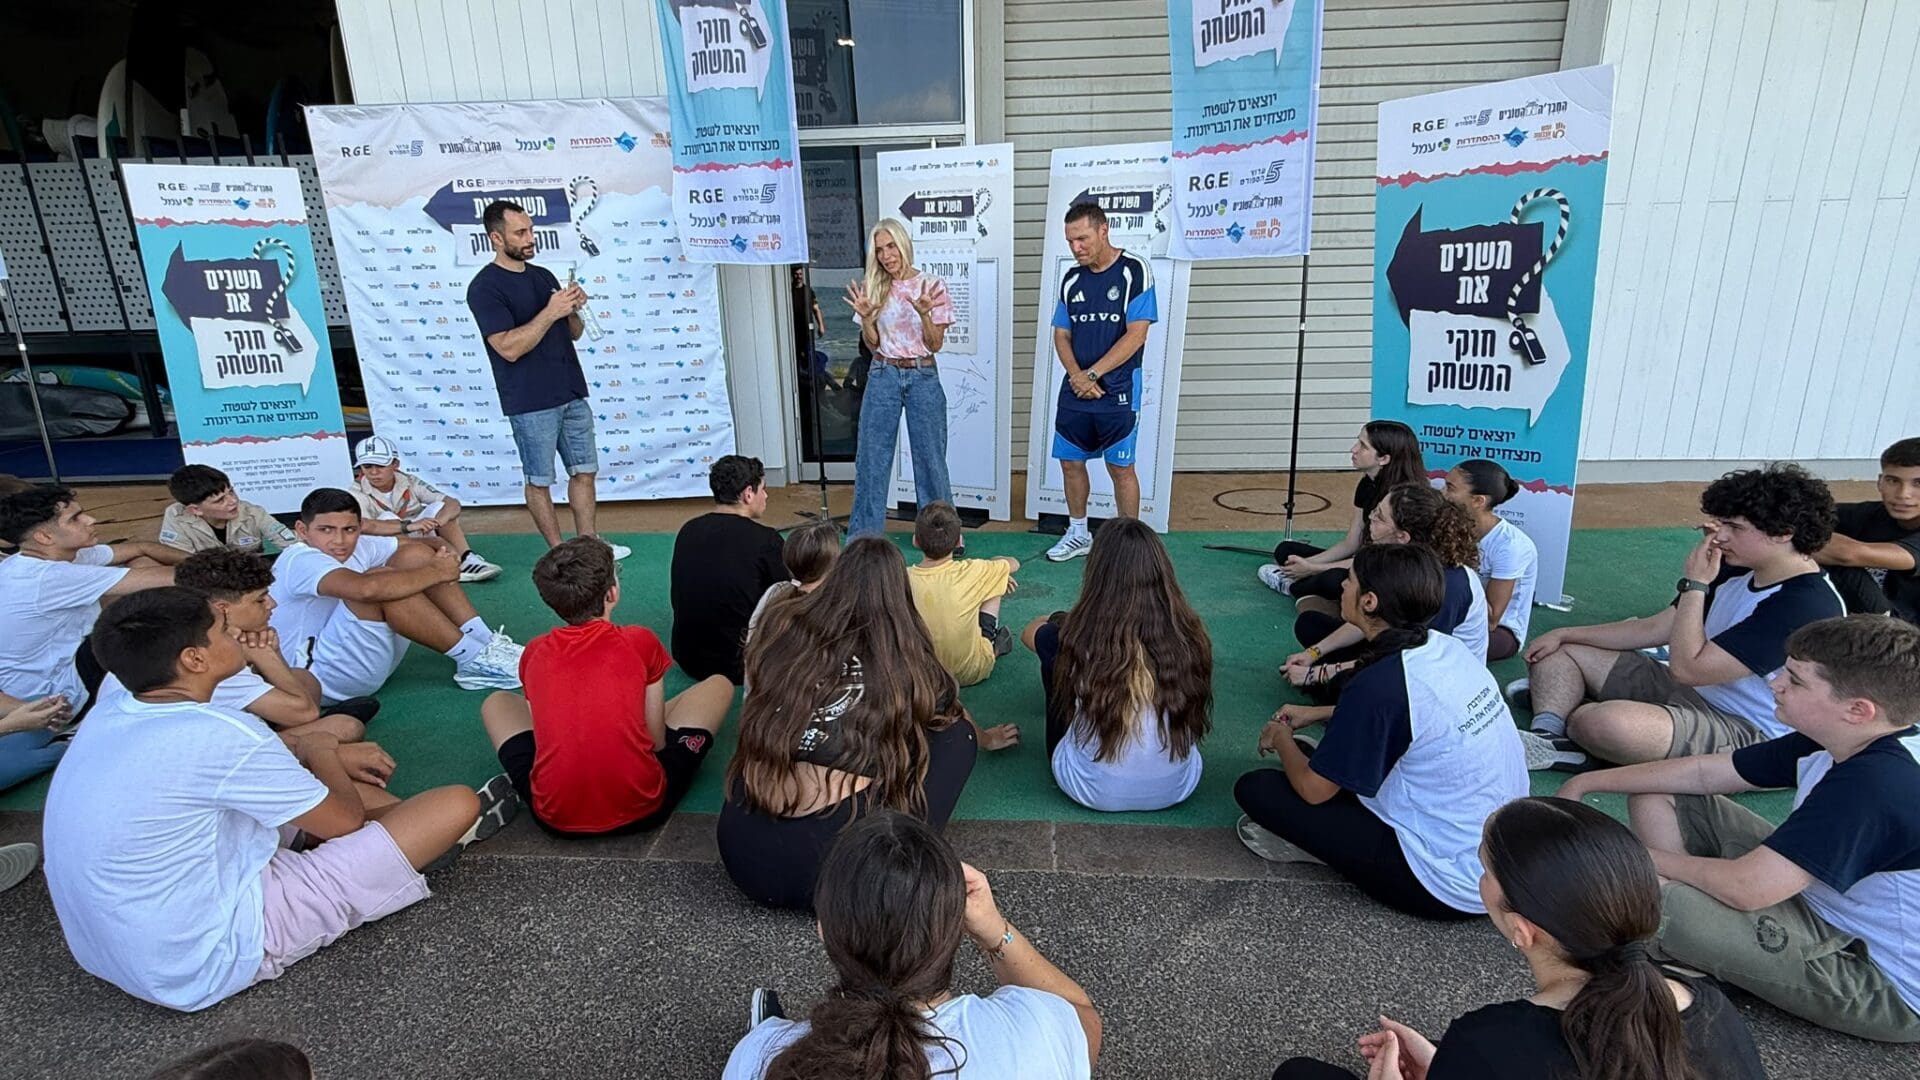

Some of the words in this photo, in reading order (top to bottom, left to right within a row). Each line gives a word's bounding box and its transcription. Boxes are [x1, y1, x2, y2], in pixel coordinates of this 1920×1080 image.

[697, 18, 731, 48] חוקי
[1200, 7, 1265, 53] המשחק
[692, 48, 746, 81] המשחק
[1238, 93, 1278, 111] יוצאים
[1233, 116, 1252, 130] את
[1254, 108, 1296, 127] מנצחים
[723, 124, 760, 135] יוצאים
[1184, 119, 1232, 140] הבריונות.
[516, 138, 542, 151] עמל
[570, 136, 612, 146] ההסתדרות
[720, 140, 736, 152] את
[738, 140, 780, 151] מנצחים
[1456, 133, 1500, 146] ההסתדרות
[1412, 142, 1436, 154] עמל
[160, 196, 182, 206] עמל
[924, 200, 936, 214] את
[938, 200, 962, 213] משנים
[1112, 196, 1140, 209] משנים
[1187, 202, 1214, 218] עמל
[689, 212, 716, 228] עמל
[950, 220, 968, 234] חוקי
[1126, 216, 1144, 230] חוקי
[920, 221, 948, 235] המשחק
[1185, 228, 1224, 236] ההסתדרות
[534, 230, 560, 254] חוק
[1440, 240, 1512, 272] משנים
[204, 270, 262, 290] משנים
[1456, 276, 1490, 304] את
[226, 292, 251, 313] את
[224, 329, 266, 351] חוקי
[1446, 330, 1496, 362] חוקי
[216, 354, 284, 379] המשחק
[1428, 362, 1512, 392] המשחק
[220, 400, 256, 413] לשטח.
[260, 400, 296, 410] יוצאים
[202, 415, 255, 426] הבריונות.
[257, 414, 275, 424] את
[280, 412, 318, 422] מנצחים
[1420, 425, 1464, 439] לשטח.
[1468, 428, 1516, 442] יוצאים
[1419, 442, 1456, 454] הבריו
[1460, 445, 1482, 458] את
[1486, 448, 1542, 463] מנצחים
